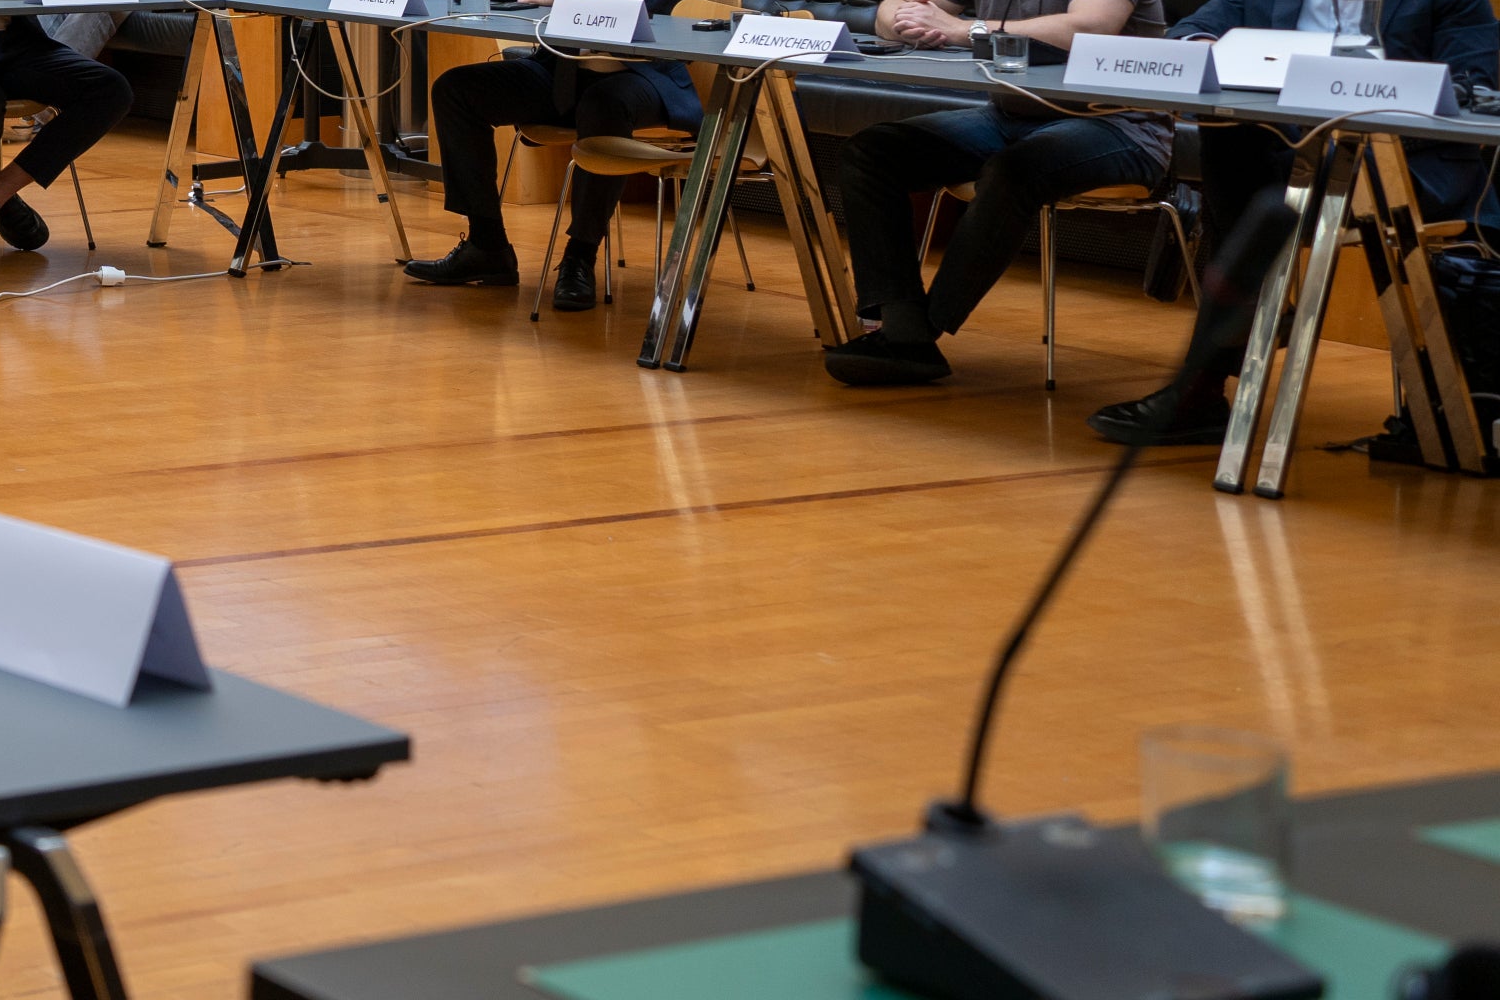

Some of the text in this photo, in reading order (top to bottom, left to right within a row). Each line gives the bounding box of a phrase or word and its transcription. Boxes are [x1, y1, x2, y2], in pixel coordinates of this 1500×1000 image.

[573, 13, 617, 29] G. LAPTII
[1095, 58, 1183, 77] Y. HEINRICH
[1330, 80, 1397, 100] O. LUKA
